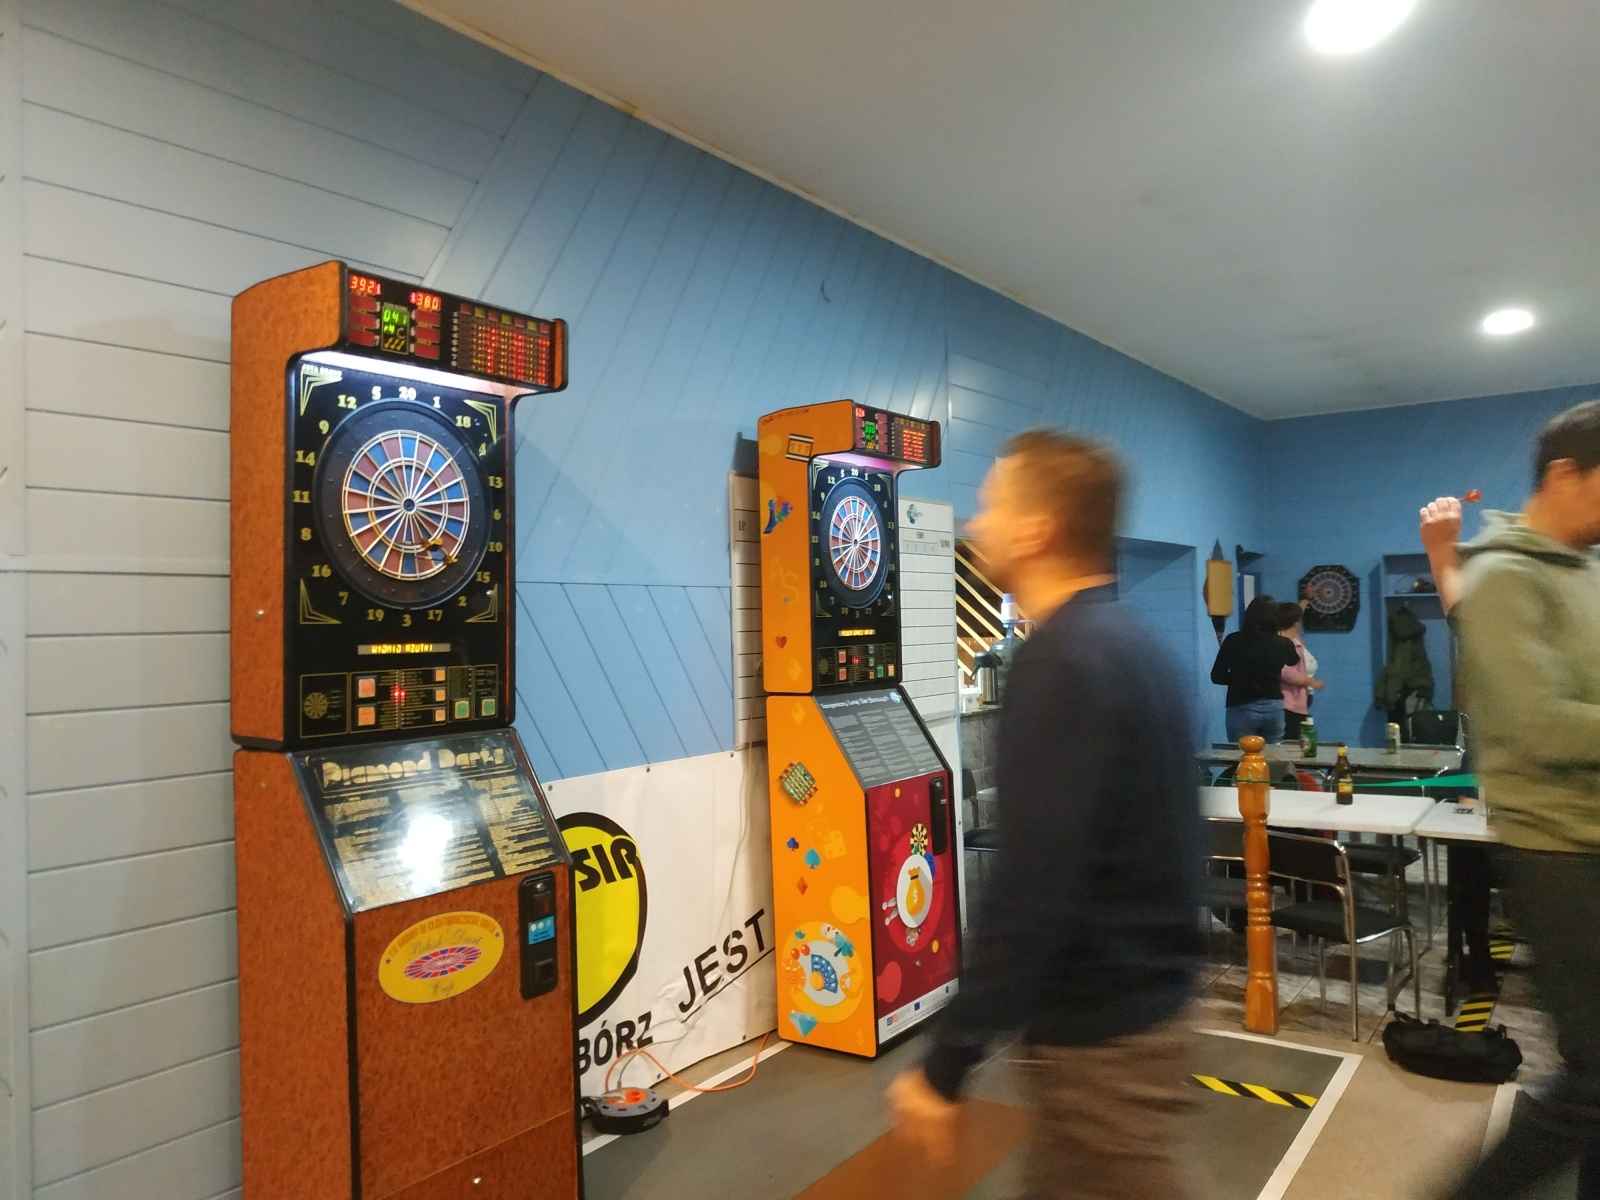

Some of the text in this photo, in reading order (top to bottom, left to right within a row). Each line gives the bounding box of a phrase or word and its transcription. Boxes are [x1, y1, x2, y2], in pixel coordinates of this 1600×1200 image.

[371, 386, 381, 400] 5
[399, 386, 417, 400] 20
[337, 394, 357, 409] 12
[433, 396, 441, 408] 1
[319, 419, 330, 434] 9
[455, 415, 471, 428] 18
[478, 442, 487, 457] 4
[295, 450, 316, 466] 14
[840, 469, 845, 478] 5
[851, 468, 859, 476] 20
[488, 475, 503, 488] 13
[827, 476, 836, 484] 12
[293, 490, 311, 503] 11
[820, 492, 826, 501] 9
[493, 509, 502, 520] 6
[301, 527, 312, 541] 8
[488, 541, 503, 552] 10
[311, 564, 332, 578] 16
[476, 571, 491, 583] 15
[338, 591, 349, 606] 7
[458, 596, 467, 607] 2
[367, 608, 385, 622] 19
[401, 614, 412, 627] 3
[427, 609, 443, 622] 17
[678, 908, 765, 1013] JEST
